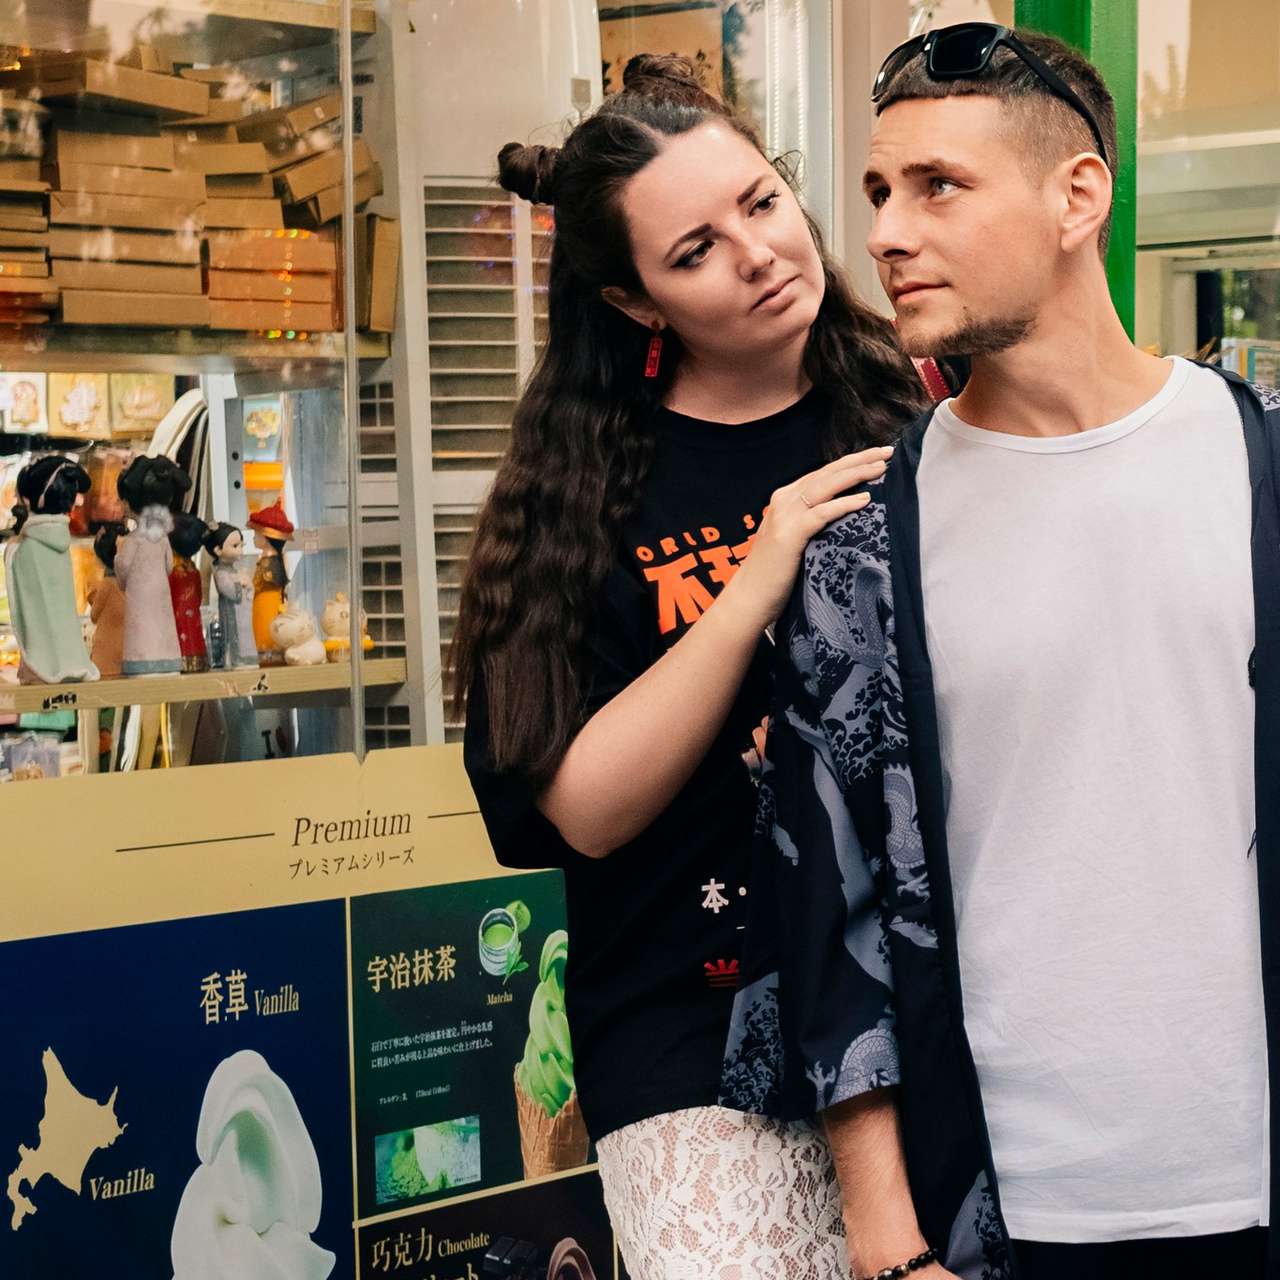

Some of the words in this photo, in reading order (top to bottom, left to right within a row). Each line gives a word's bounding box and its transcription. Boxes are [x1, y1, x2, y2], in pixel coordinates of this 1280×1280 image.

[291, 809, 412, 847] Premium
[289, 846, 415, 880] プレミアムシリーズ
[367, 945, 457, 993] 宇治抹茶
[200, 969, 249, 1025] 香草
[254, 984, 300, 1016] Vanilla
[486, 990, 513, 1006] Matcha
[89, 1166, 155, 1201] Vanilla
[371, 1227, 433, 1272] 巧克力
[438, 1231, 490, 1257] Chocolate
